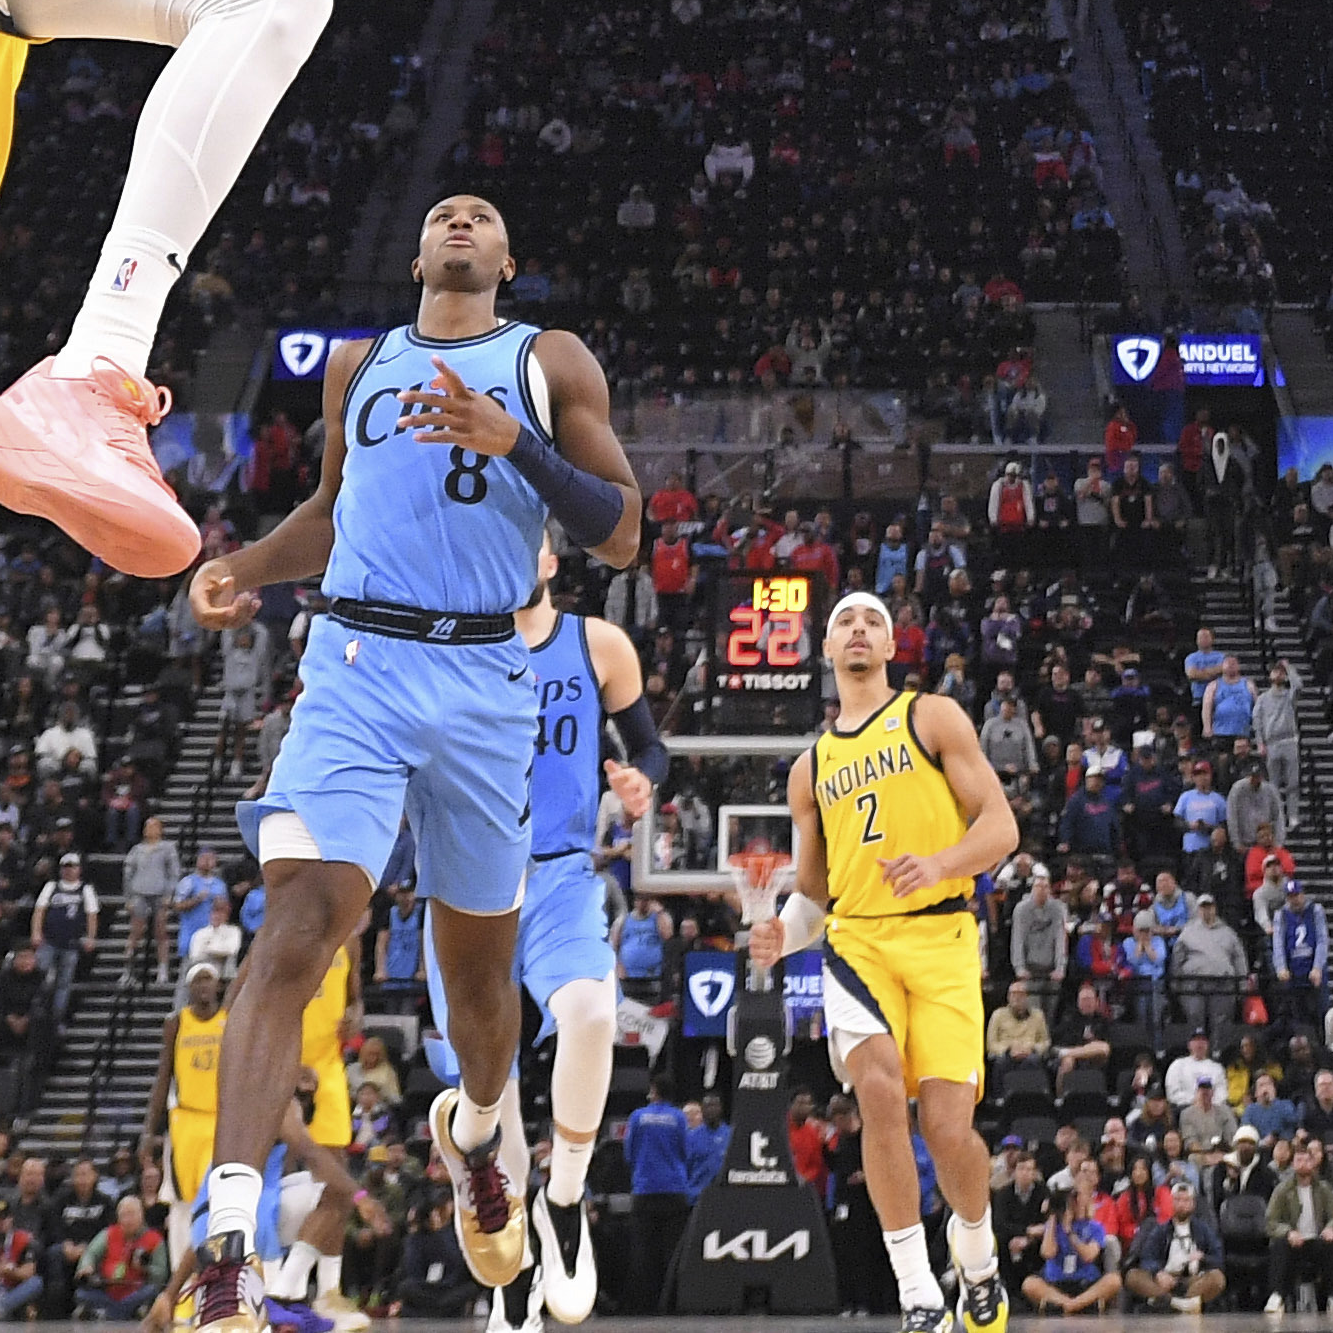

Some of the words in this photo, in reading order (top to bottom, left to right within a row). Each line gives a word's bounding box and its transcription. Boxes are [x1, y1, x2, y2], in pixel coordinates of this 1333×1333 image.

[1178, 343, 1257, 362] ANDUEL
[444, 445, 489, 505] 8
[753, 577, 808, 612] 1:30
[728, 607, 802, 666] 22
[742, 673, 812, 690] TISSOT
[816, 743, 914, 811] INDIANA
[856, 792, 883, 845] 2
